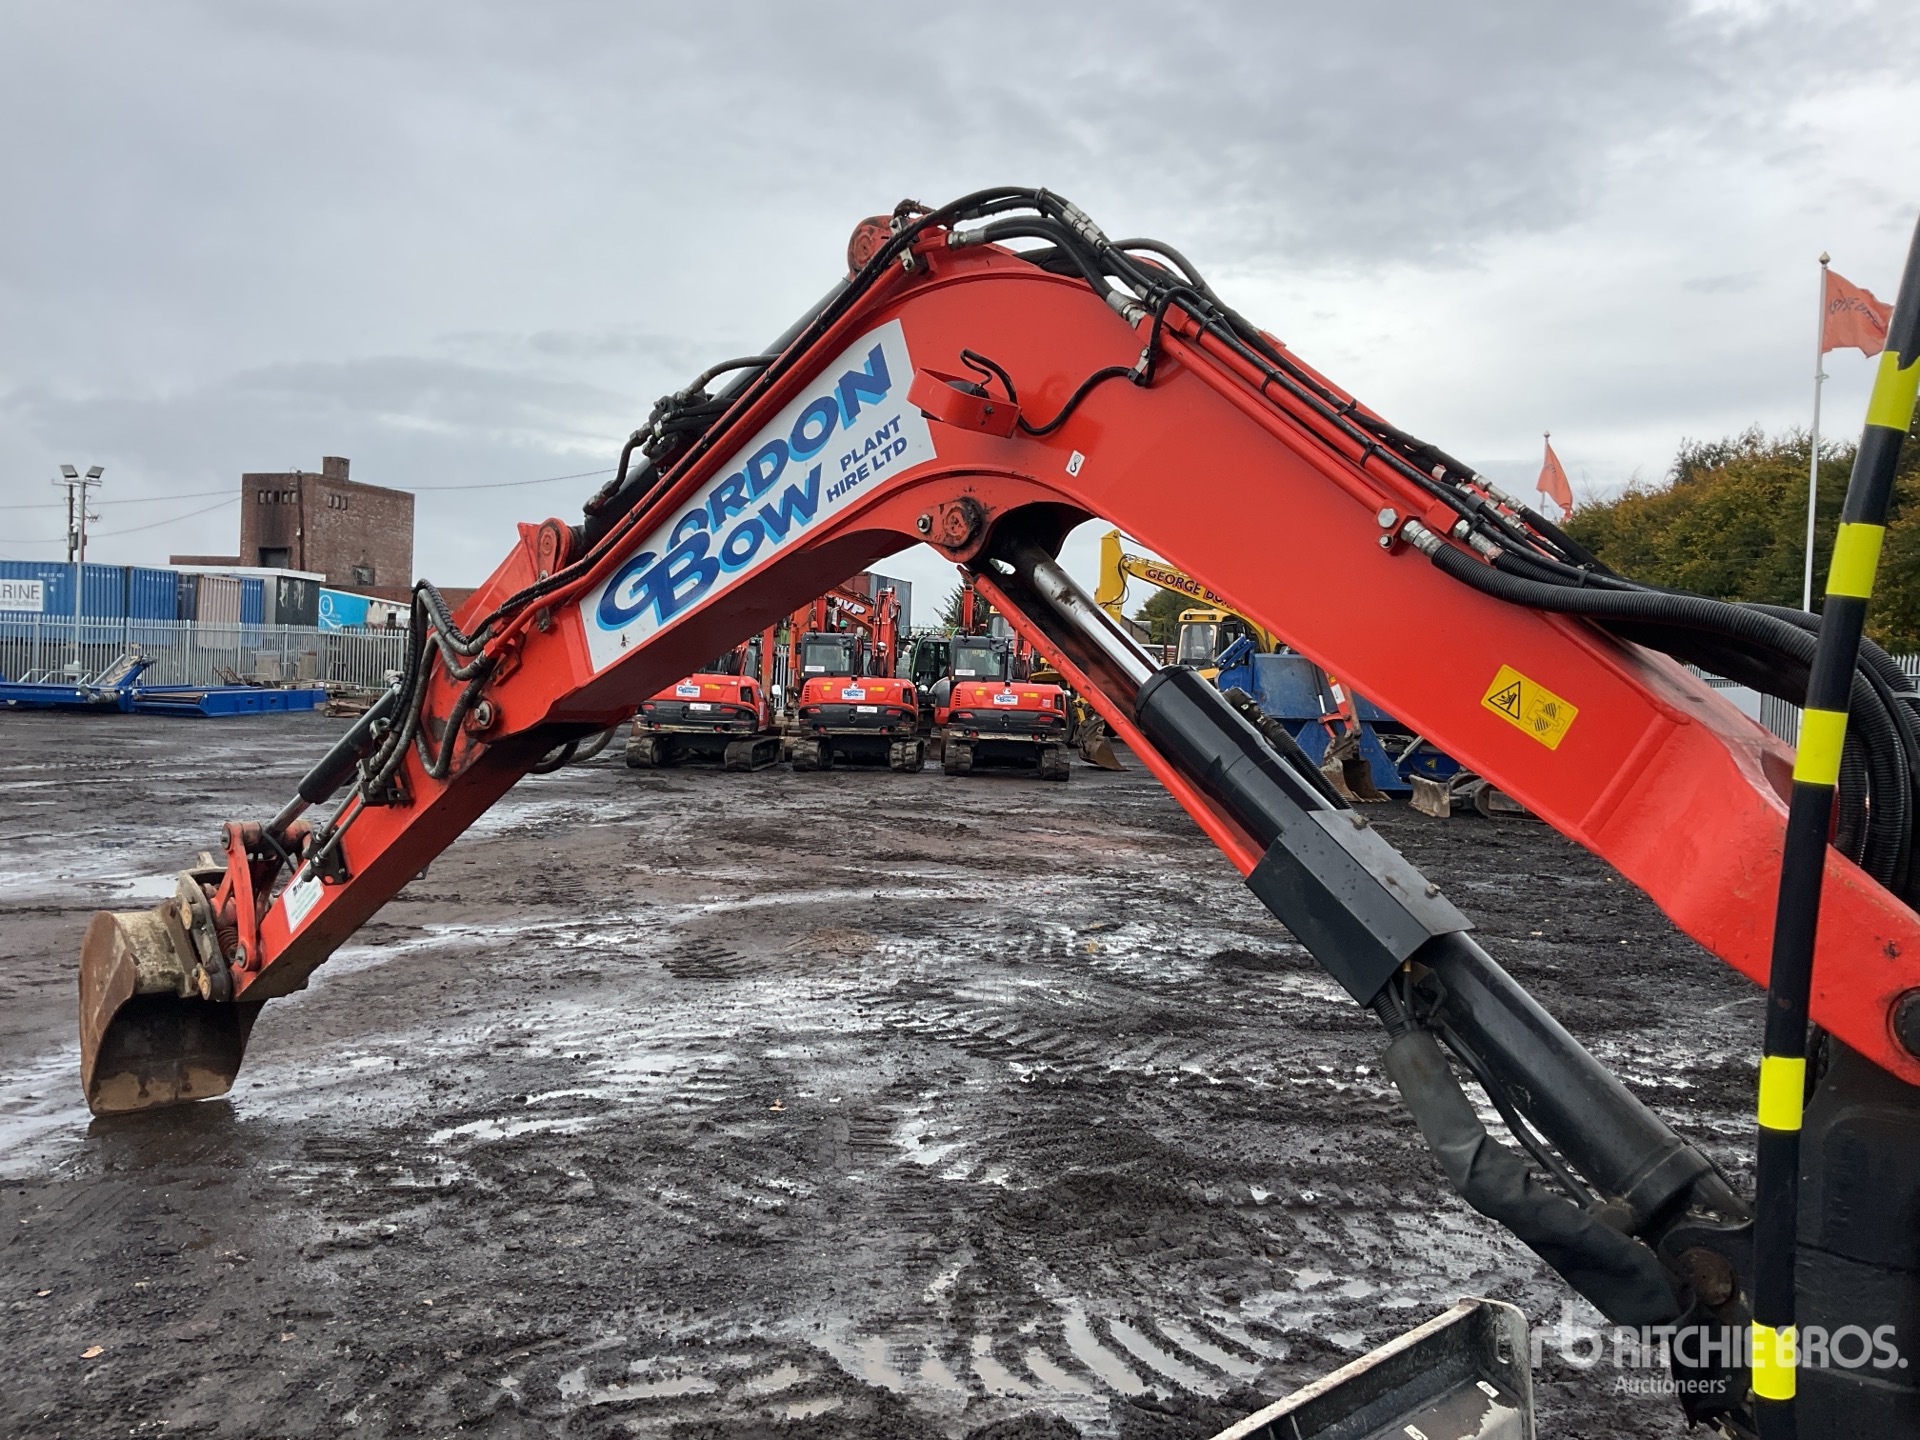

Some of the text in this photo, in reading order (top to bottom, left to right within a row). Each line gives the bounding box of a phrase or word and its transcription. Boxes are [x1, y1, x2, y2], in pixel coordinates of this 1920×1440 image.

[826, 436, 908, 503] HIRE LTD
[840, 414, 901, 473] PLANT
[596, 342, 892, 631] GORDON
[653, 461, 823, 627] BOW
[0, 584, 40, 600] RINE
[1145, 568, 1201, 595] GEORGE
